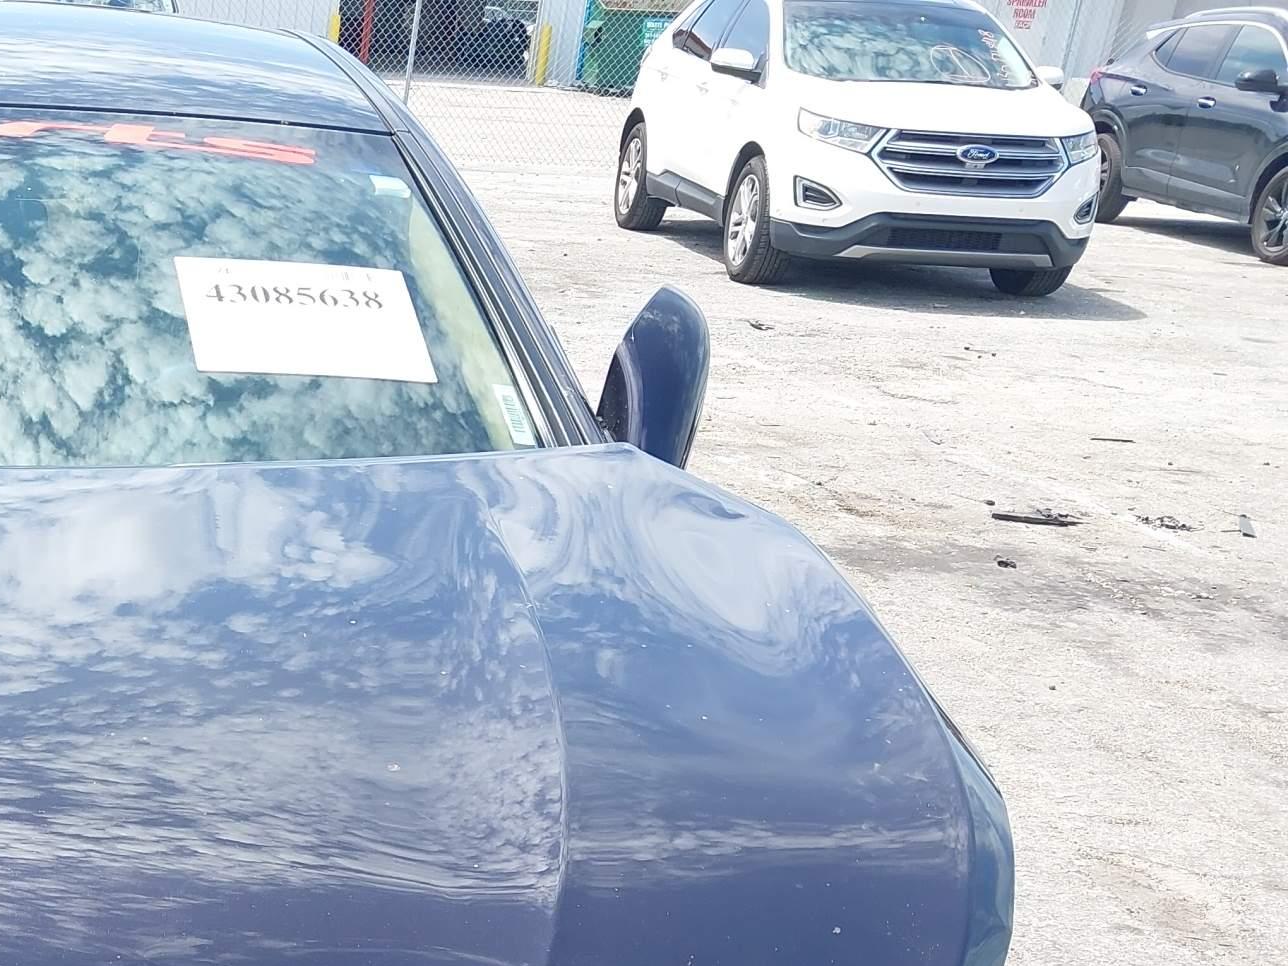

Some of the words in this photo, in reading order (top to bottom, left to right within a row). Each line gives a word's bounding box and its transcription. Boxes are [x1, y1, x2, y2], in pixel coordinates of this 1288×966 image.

[1012, 8, 1037, 19] ROOM
[968, 148, 990, 159] Ford
[205, 282, 384, 310] 43085638
